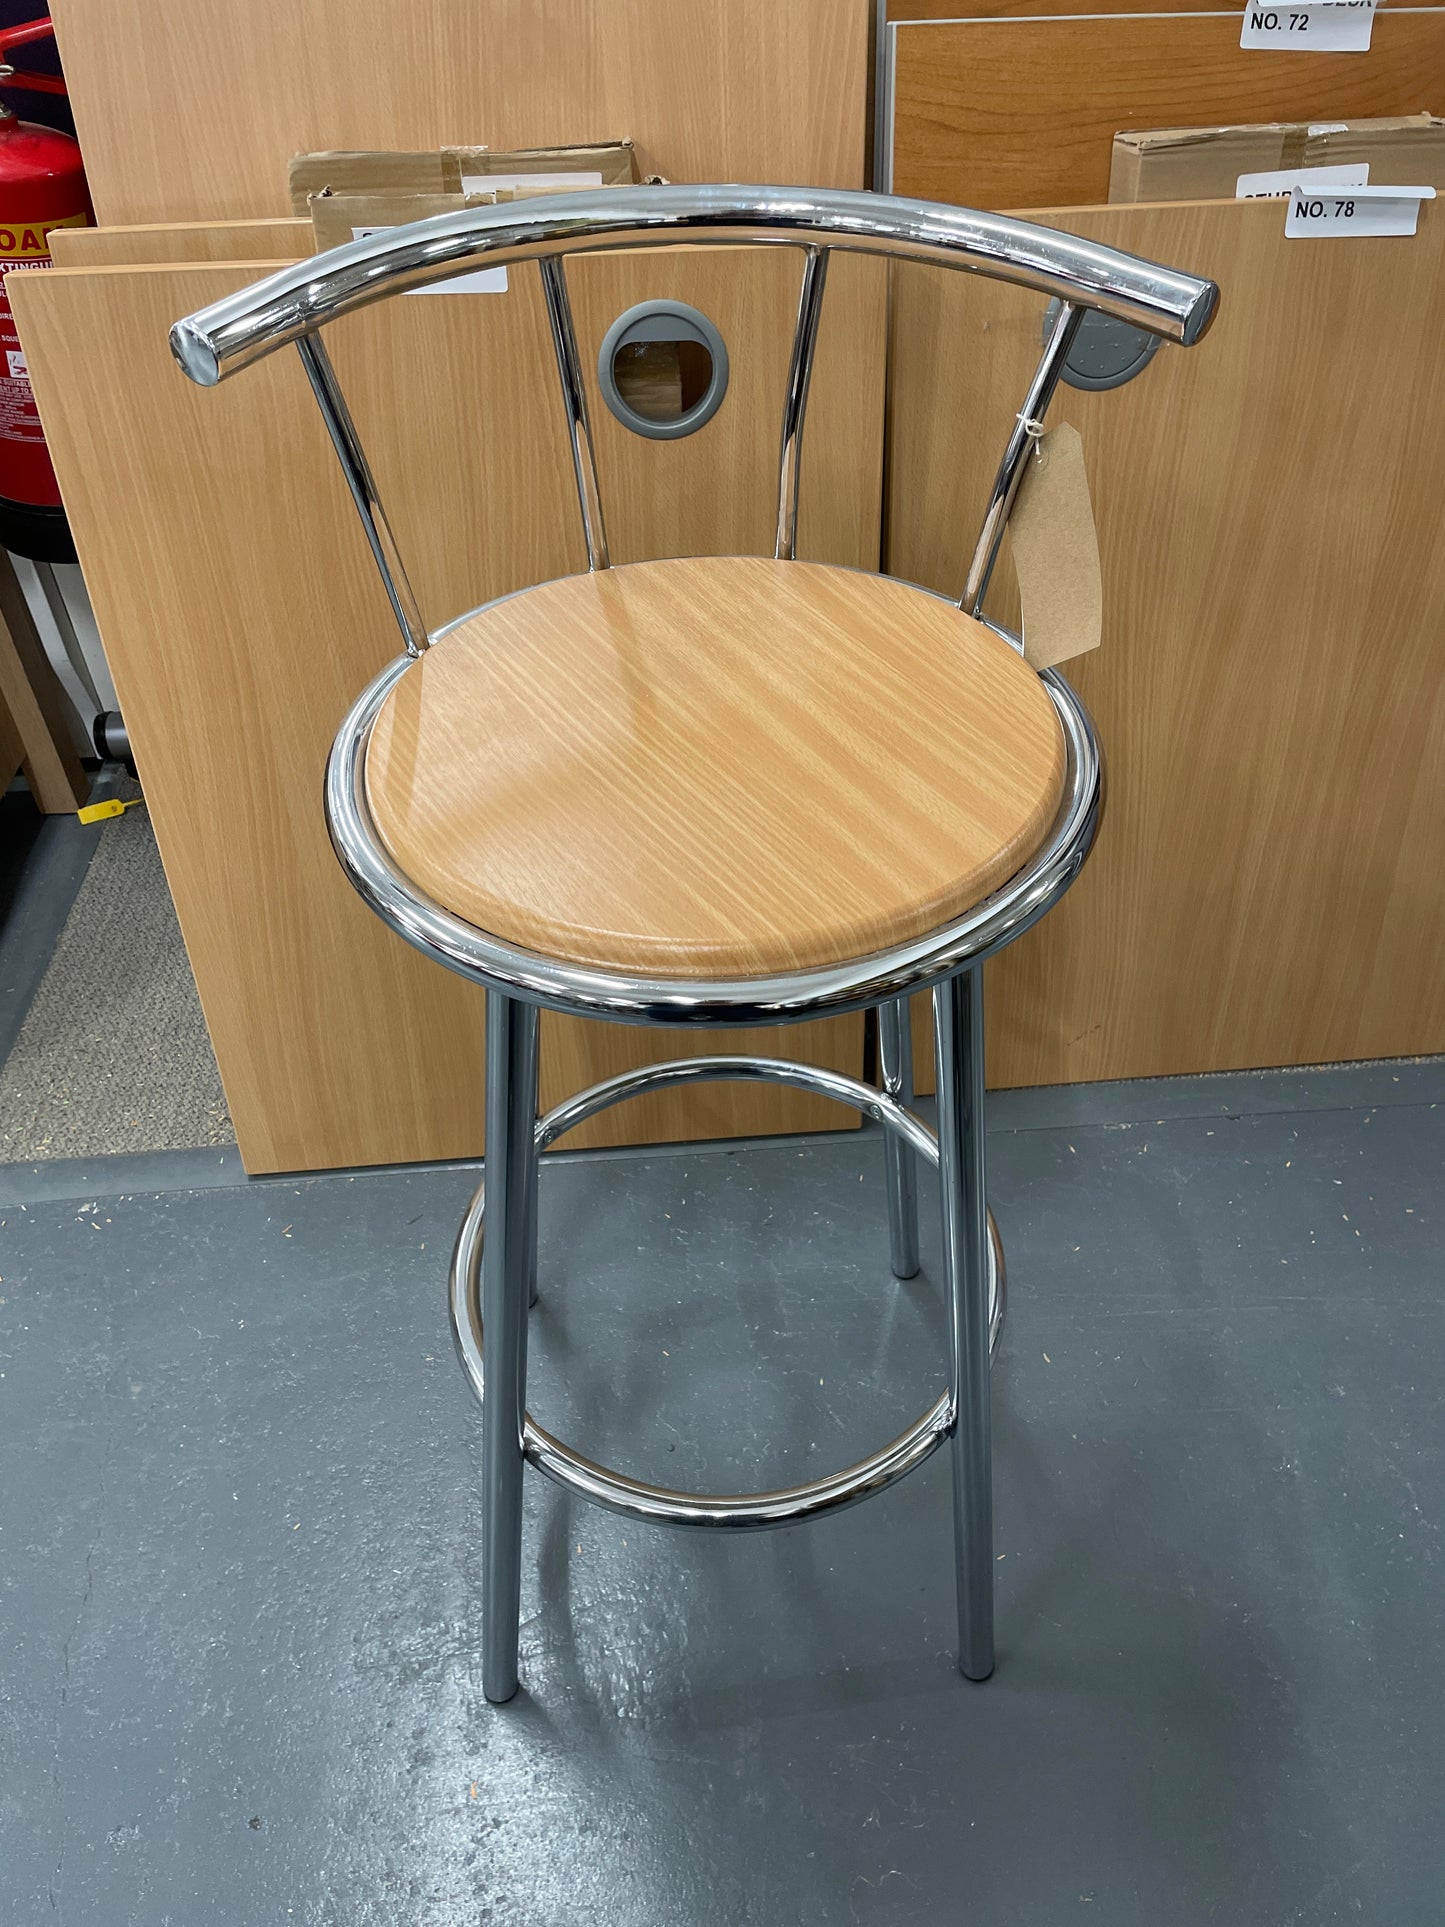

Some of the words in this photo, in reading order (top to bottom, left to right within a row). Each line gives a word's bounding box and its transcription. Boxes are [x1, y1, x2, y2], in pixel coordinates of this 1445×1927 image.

[1250, 12, 1282, 30] NO.
[1289, 13, 1309, 31] 72
[1295, 201, 1328, 218] NO.
[1334, 200, 1355, 218] 78
